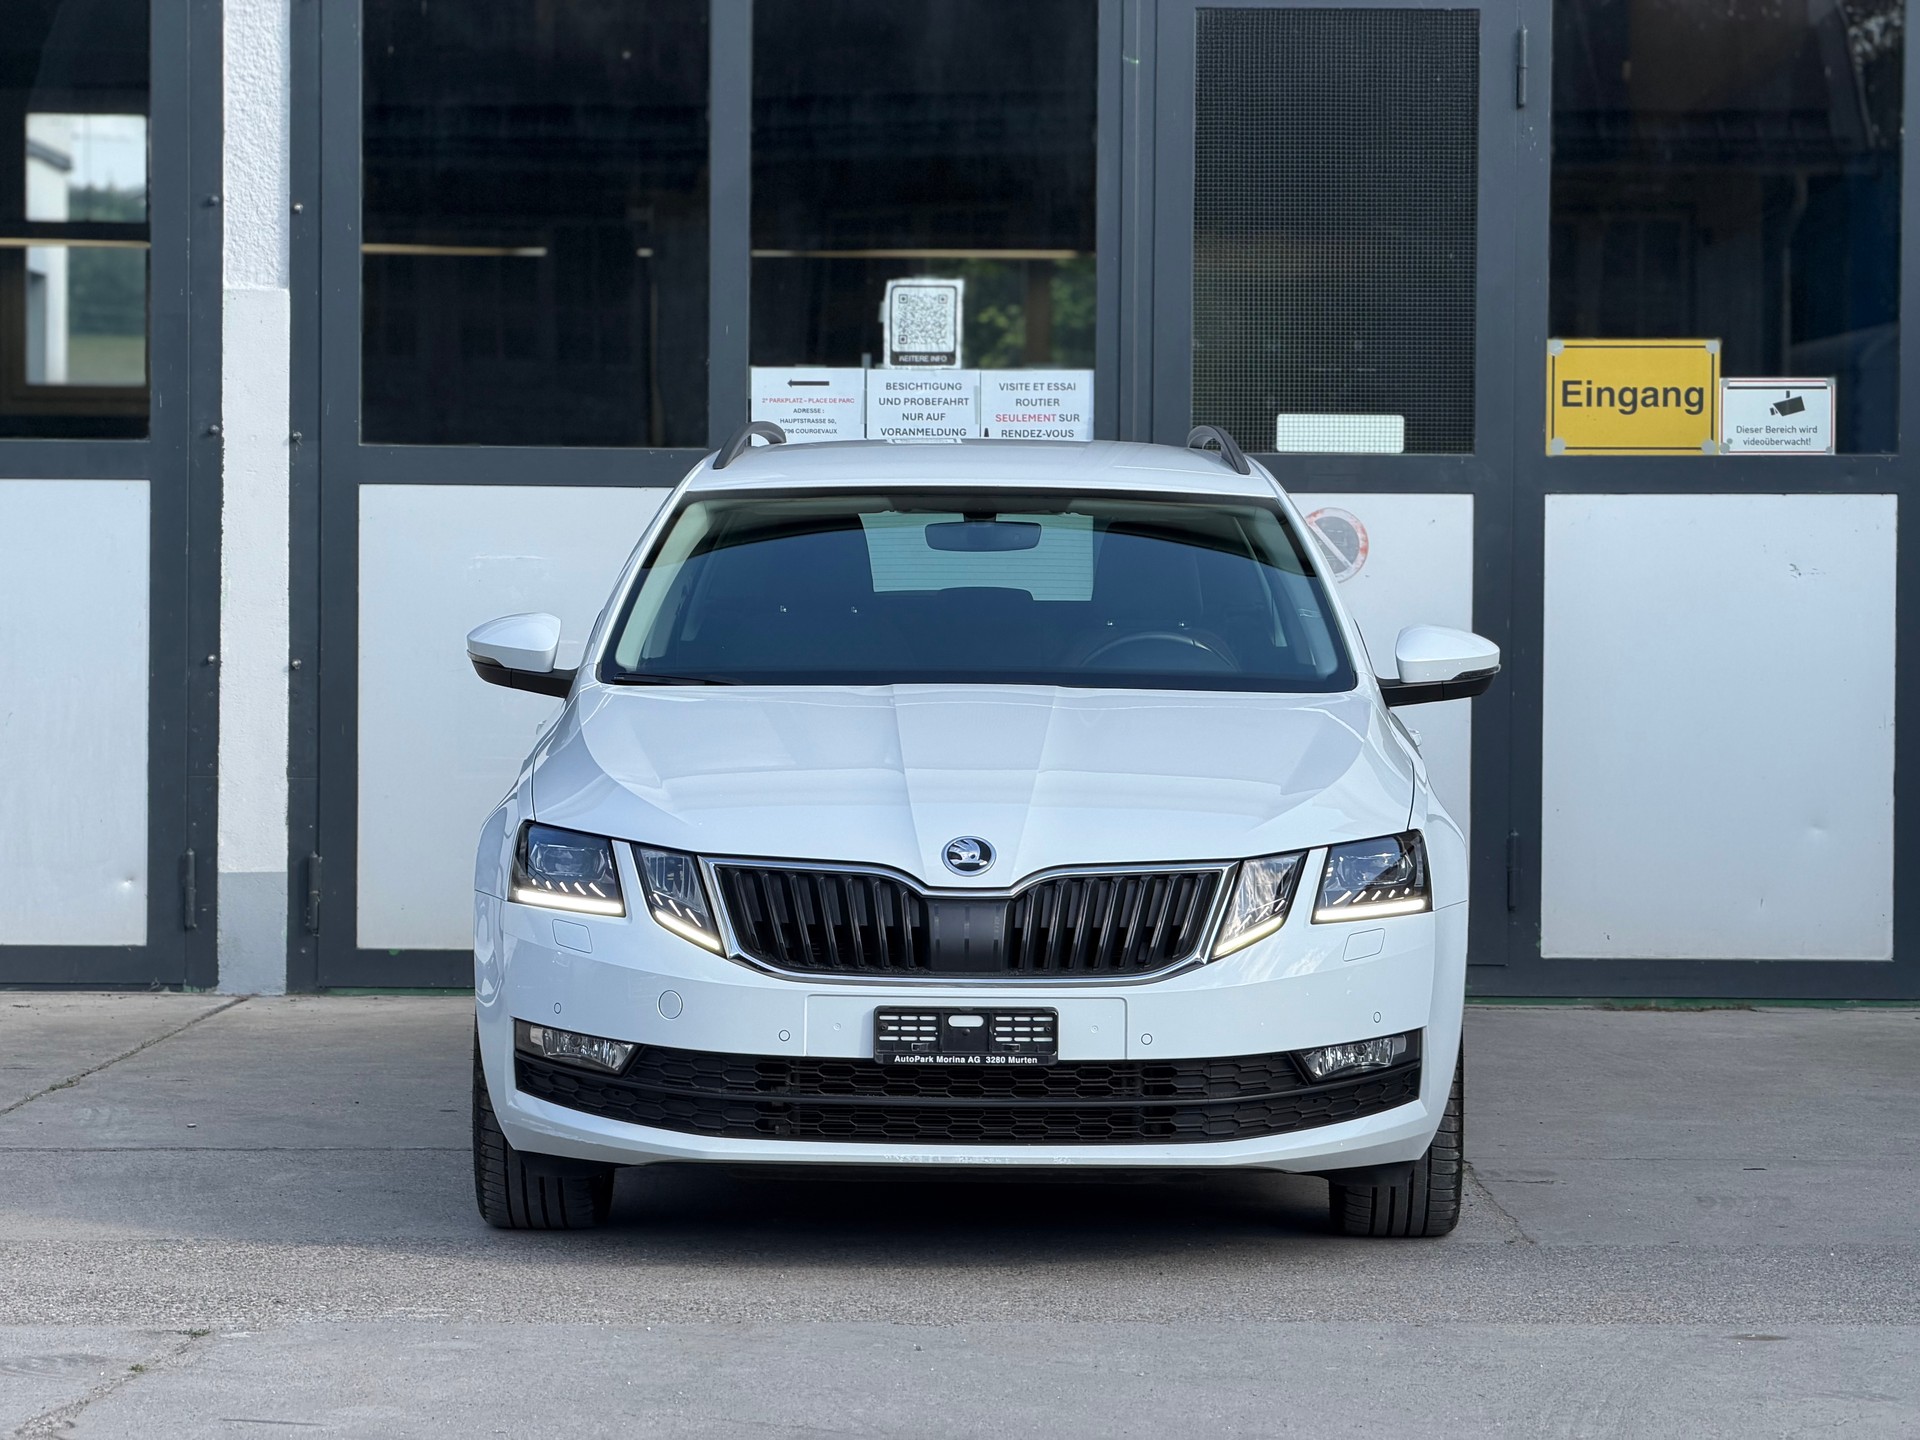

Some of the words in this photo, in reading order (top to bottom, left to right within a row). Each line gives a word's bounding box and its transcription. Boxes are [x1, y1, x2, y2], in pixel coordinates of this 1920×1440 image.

[930, 354, 948, 363] INFO
[885, 382, 963, 391] BESICHTIGUNG
[998, 382, 1031, 391] VISITE
[1033, 382, 1045, 391] ET
[1047, 382, 1076, 391] ESSAI
[878, 397, 902, 406] UND
[903, 397, 970, 406] PROBEFAHRT
[1561, 379, 1705, 416] Eingang
[1015, 398, 1060, 407] ROUTIER
[902, 412, 924, 421] NUR
[926, 412, 946, 421] AUF
[995, 413, 1057, 423] SEULEMENT
[1058, 413, 1080, 423] SUR
[880, 427, 967, 437] VORANMELDUNG
[1001, 429, 1075, 438] RENDEZ-VOUS
[1736, 425, 1763, 434] Dieser
[1765, 425, 1797, 434] Bereich
[1798, 425, 1818, 434] wird
[1742, 437, 1812, 446] videoüberwacht!
[894, 1055, 934, 1063] AutoPark
[936, 1055, 965, 1064] Morina
[967, 1056, 981, 1064] AG
[985, 1056, 1006, 1064] 3280
[1008, 1056, 1038, 1064] Murten
